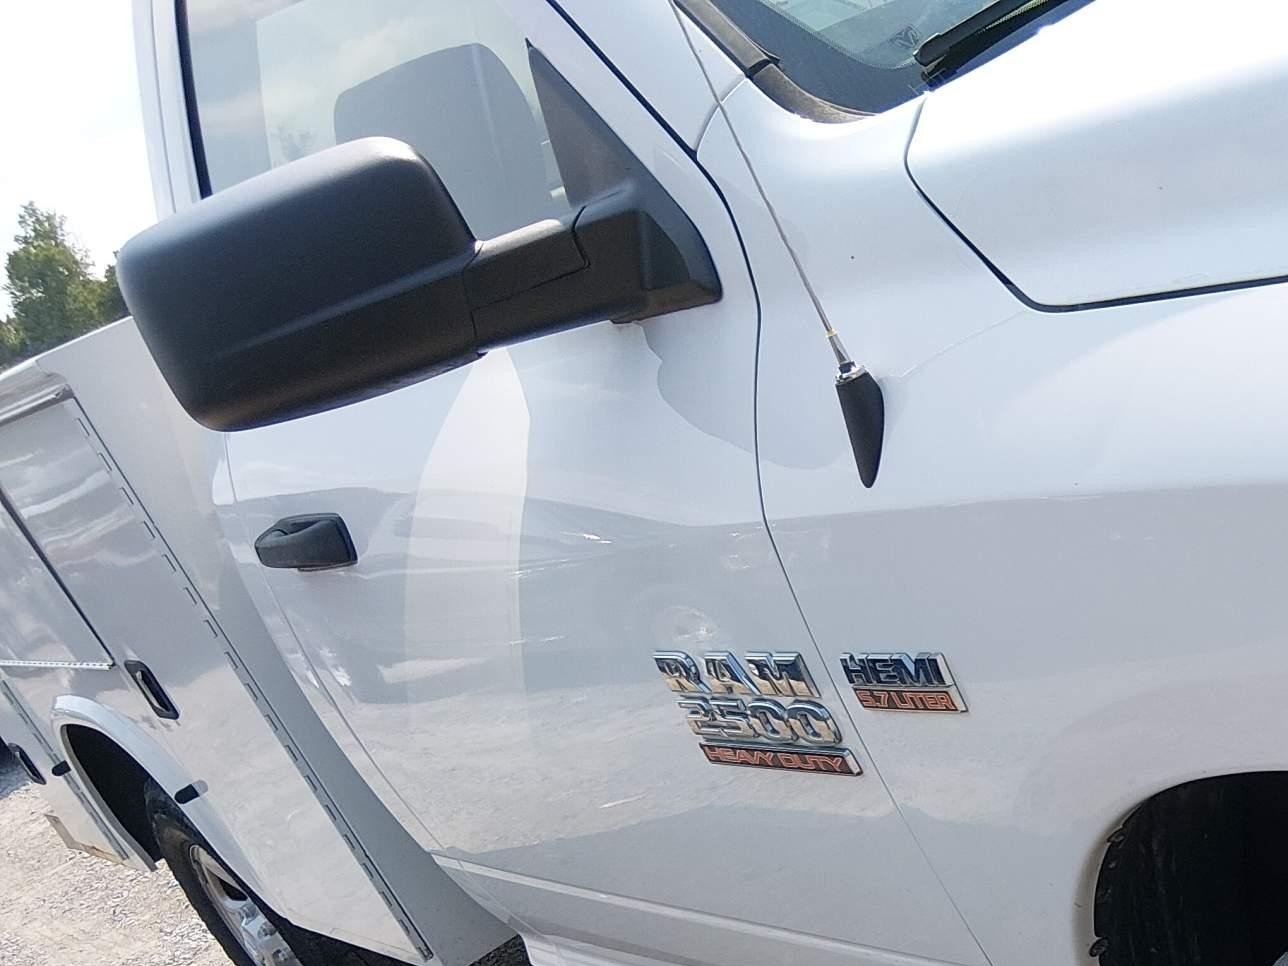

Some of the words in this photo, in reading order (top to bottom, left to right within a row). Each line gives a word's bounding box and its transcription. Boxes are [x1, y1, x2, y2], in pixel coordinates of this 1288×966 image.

[652, 650, 822, 699] RAM
[840, 652, 957, 688] HEMI
[890, 691, 955, 711] LITER
[676, 695, 843, 744] 2500
[707, 745, 774, 766] HEAVY
[780, 753, 843, 772] DUTY
